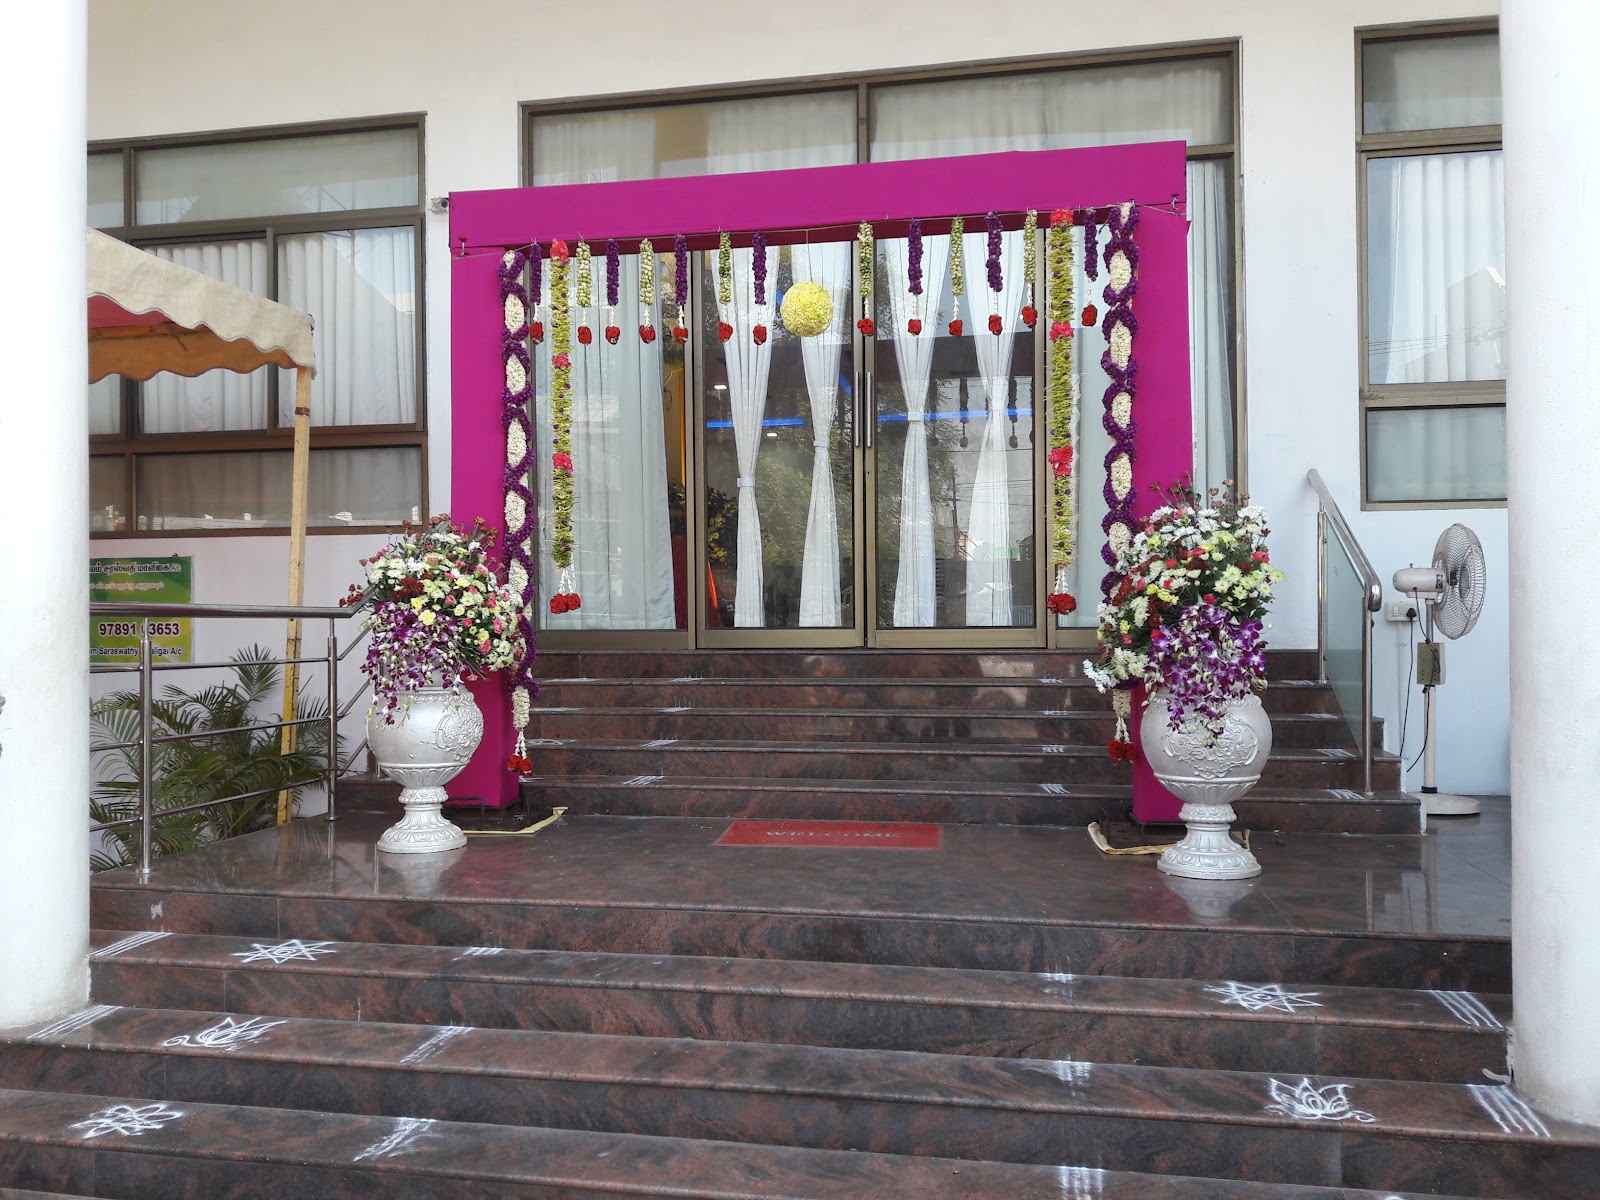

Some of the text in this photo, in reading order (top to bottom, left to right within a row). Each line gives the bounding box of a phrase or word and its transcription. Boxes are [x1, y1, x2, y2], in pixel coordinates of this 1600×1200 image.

[99, 623, 136, 636] 97891
[98, 647, 139, 657] Saraswathy
[148, 647, 169, 656] aligai
[170, 647, 182, 655] A/c
